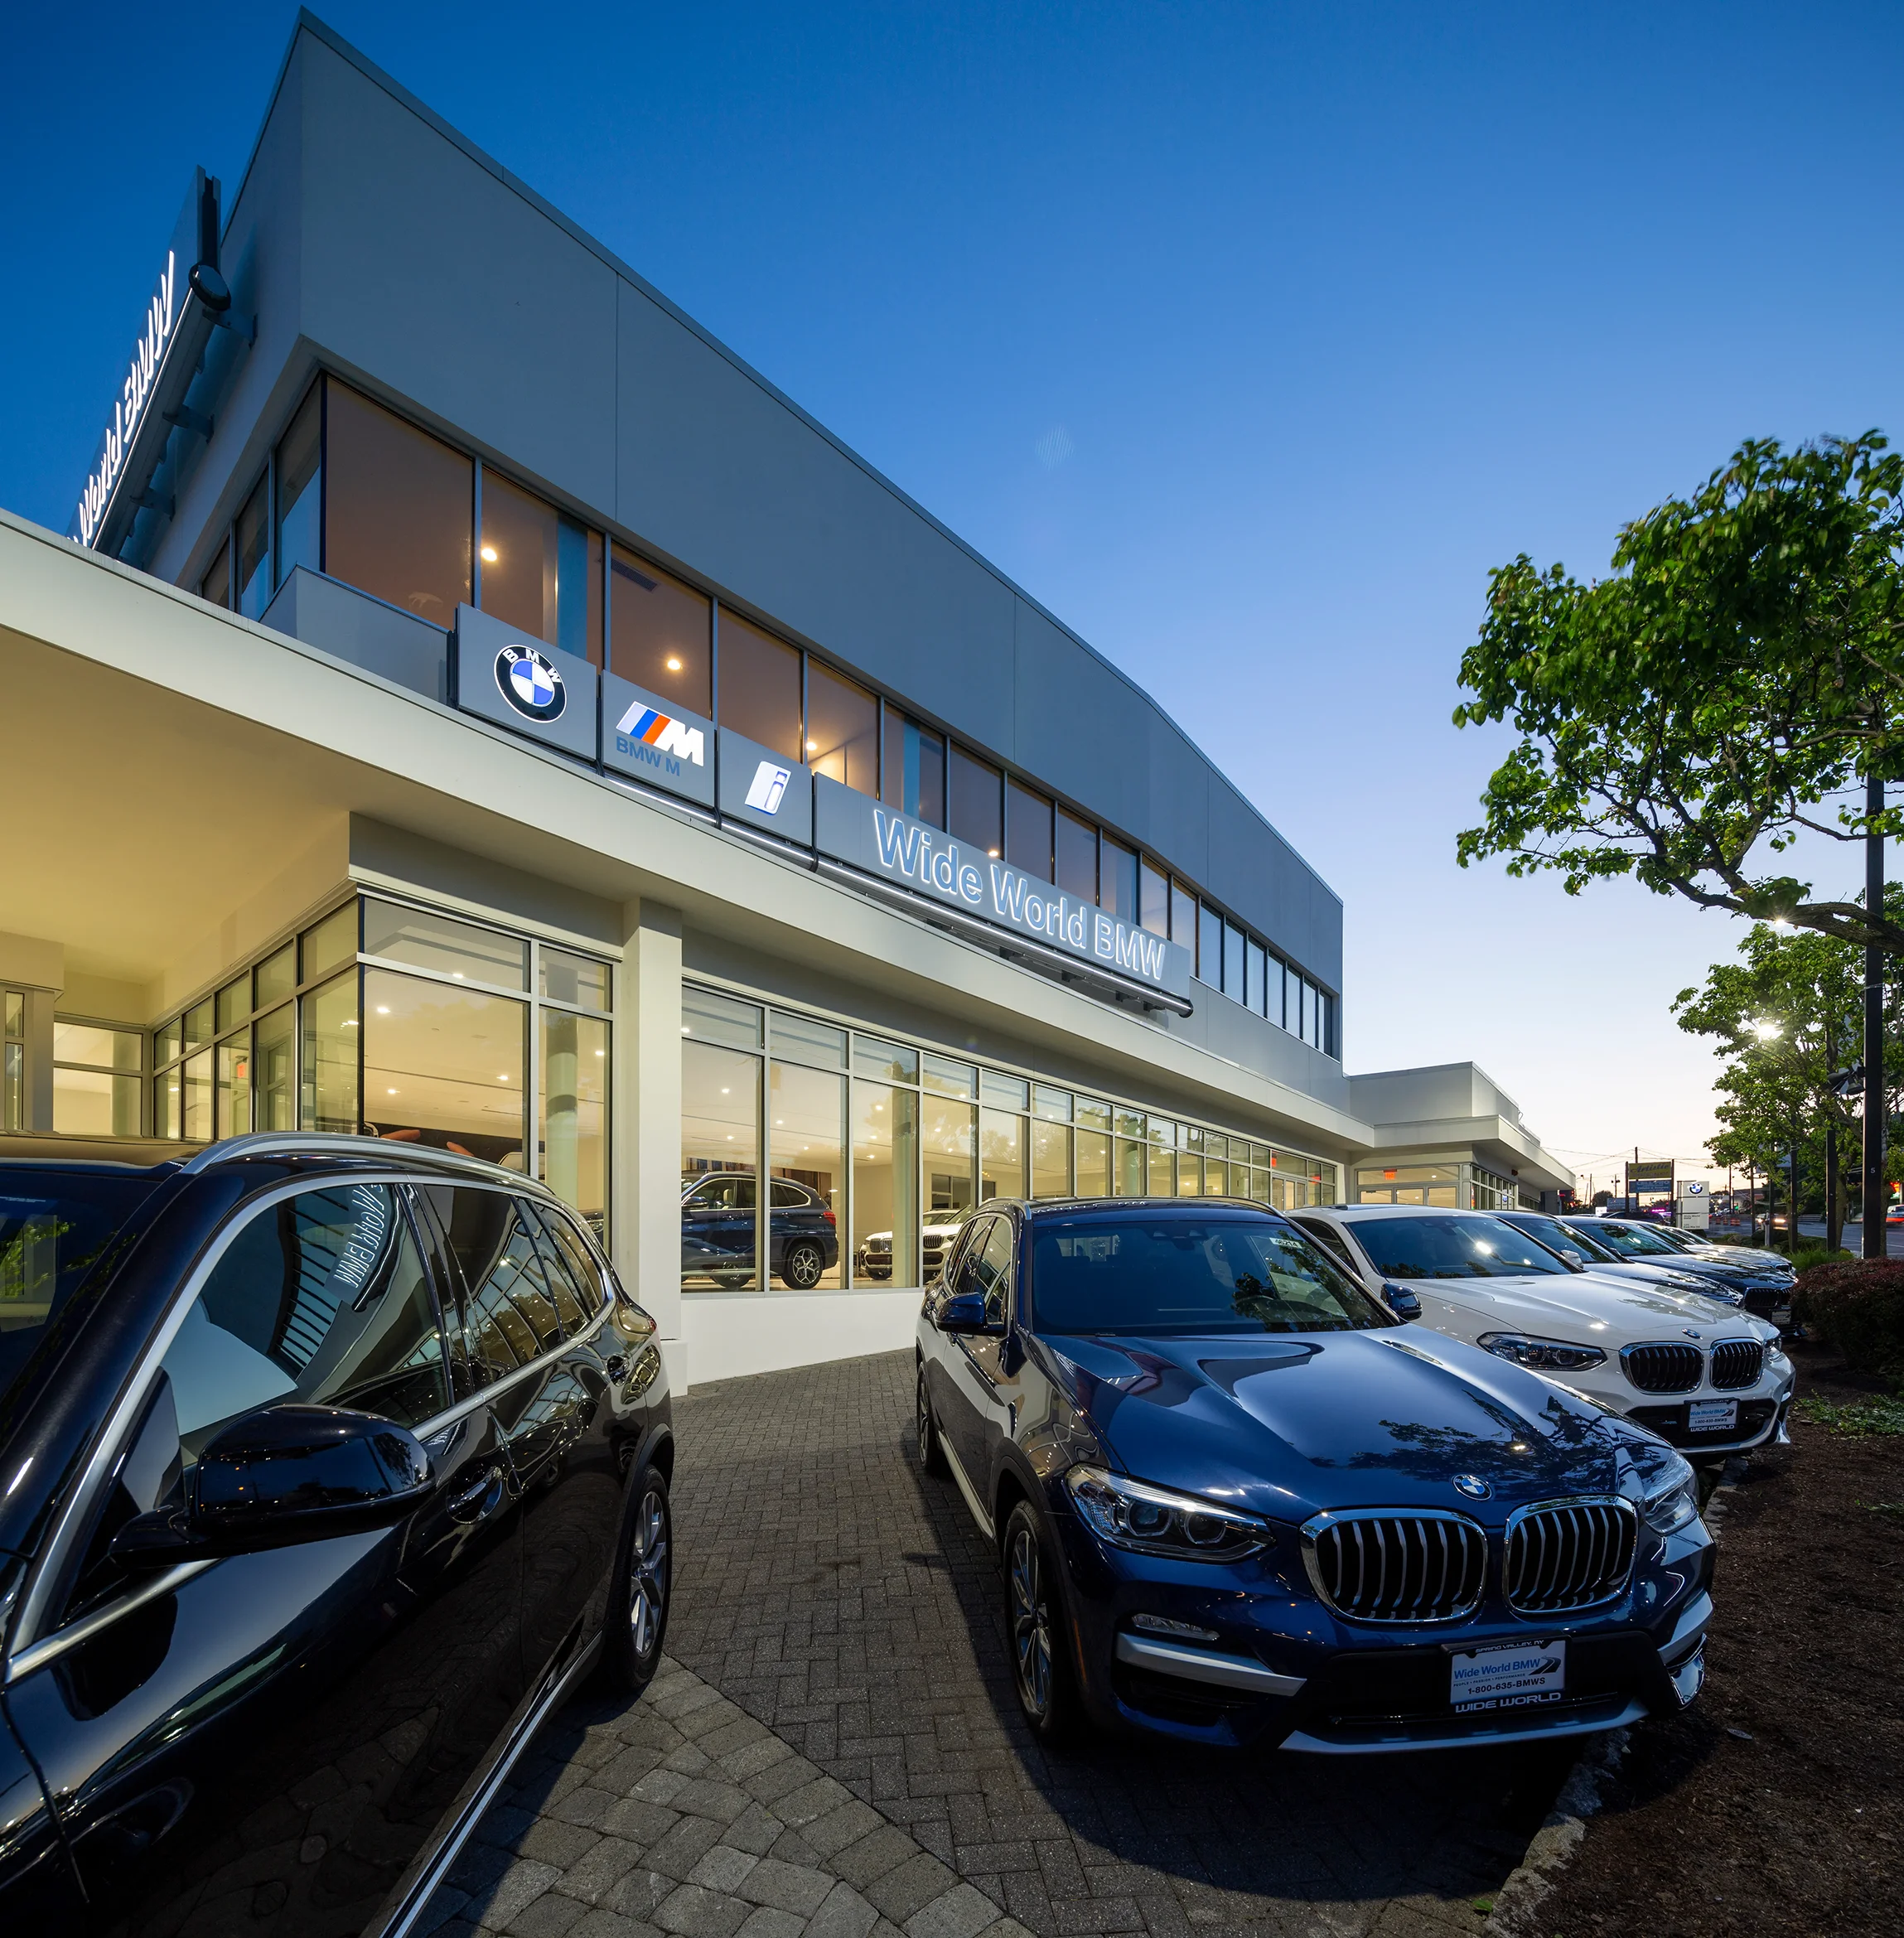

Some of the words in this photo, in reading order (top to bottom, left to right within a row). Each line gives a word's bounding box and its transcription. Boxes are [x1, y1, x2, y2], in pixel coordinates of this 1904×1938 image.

[503, 647, 562, 684] BMW
[616, 736, 661, 769] BMW
[665, 757, 680, 776] M
[873, 809, 983, 903] Wide
[989, 863, 1088, 949] World
[1094, 914, 1167, 981] BMW
[1454, 1668, 1480, 1679] Wide
[1481, 1663, 1510, 1675] World
[1512, 1658, 1540, 1670] BMW
[1467, 1677, 1545, 1694] 1-800-635-BMWS
[1455, 1699, 1497, 1713] WIDE
[1500, 1692, 1562, 1707] WORLD
